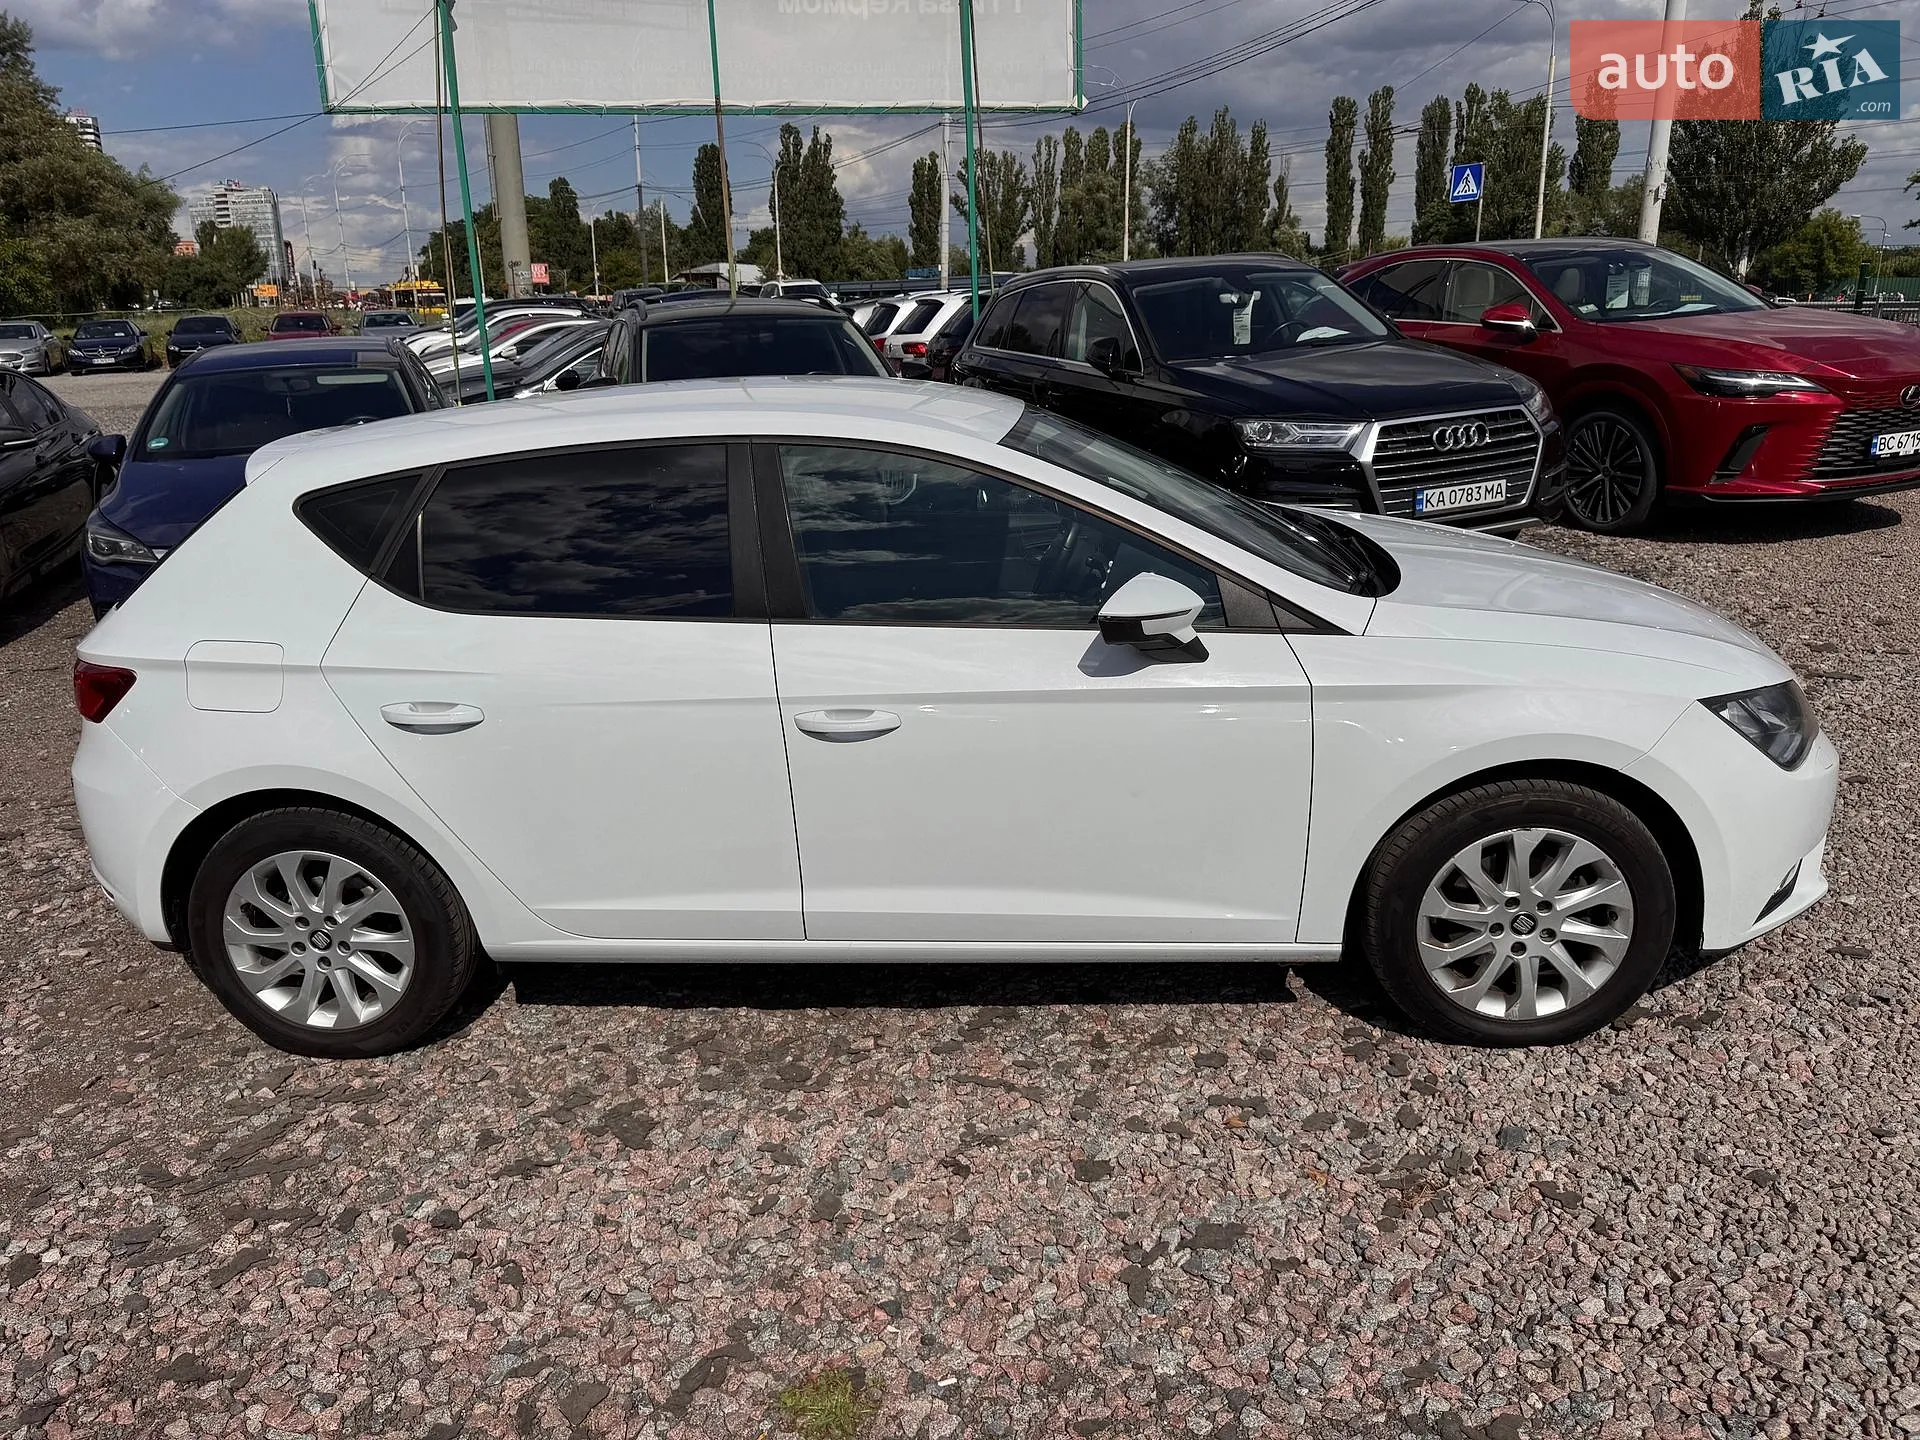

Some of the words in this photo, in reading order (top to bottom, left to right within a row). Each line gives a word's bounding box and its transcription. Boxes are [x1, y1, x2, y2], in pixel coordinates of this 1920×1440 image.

[1878, 435, 1895, 452] BC
[1425, 491, 1445, 509] KA
[1449, 485, 1482, 505] 0783
[1484, 482, 1504, 501] MA
